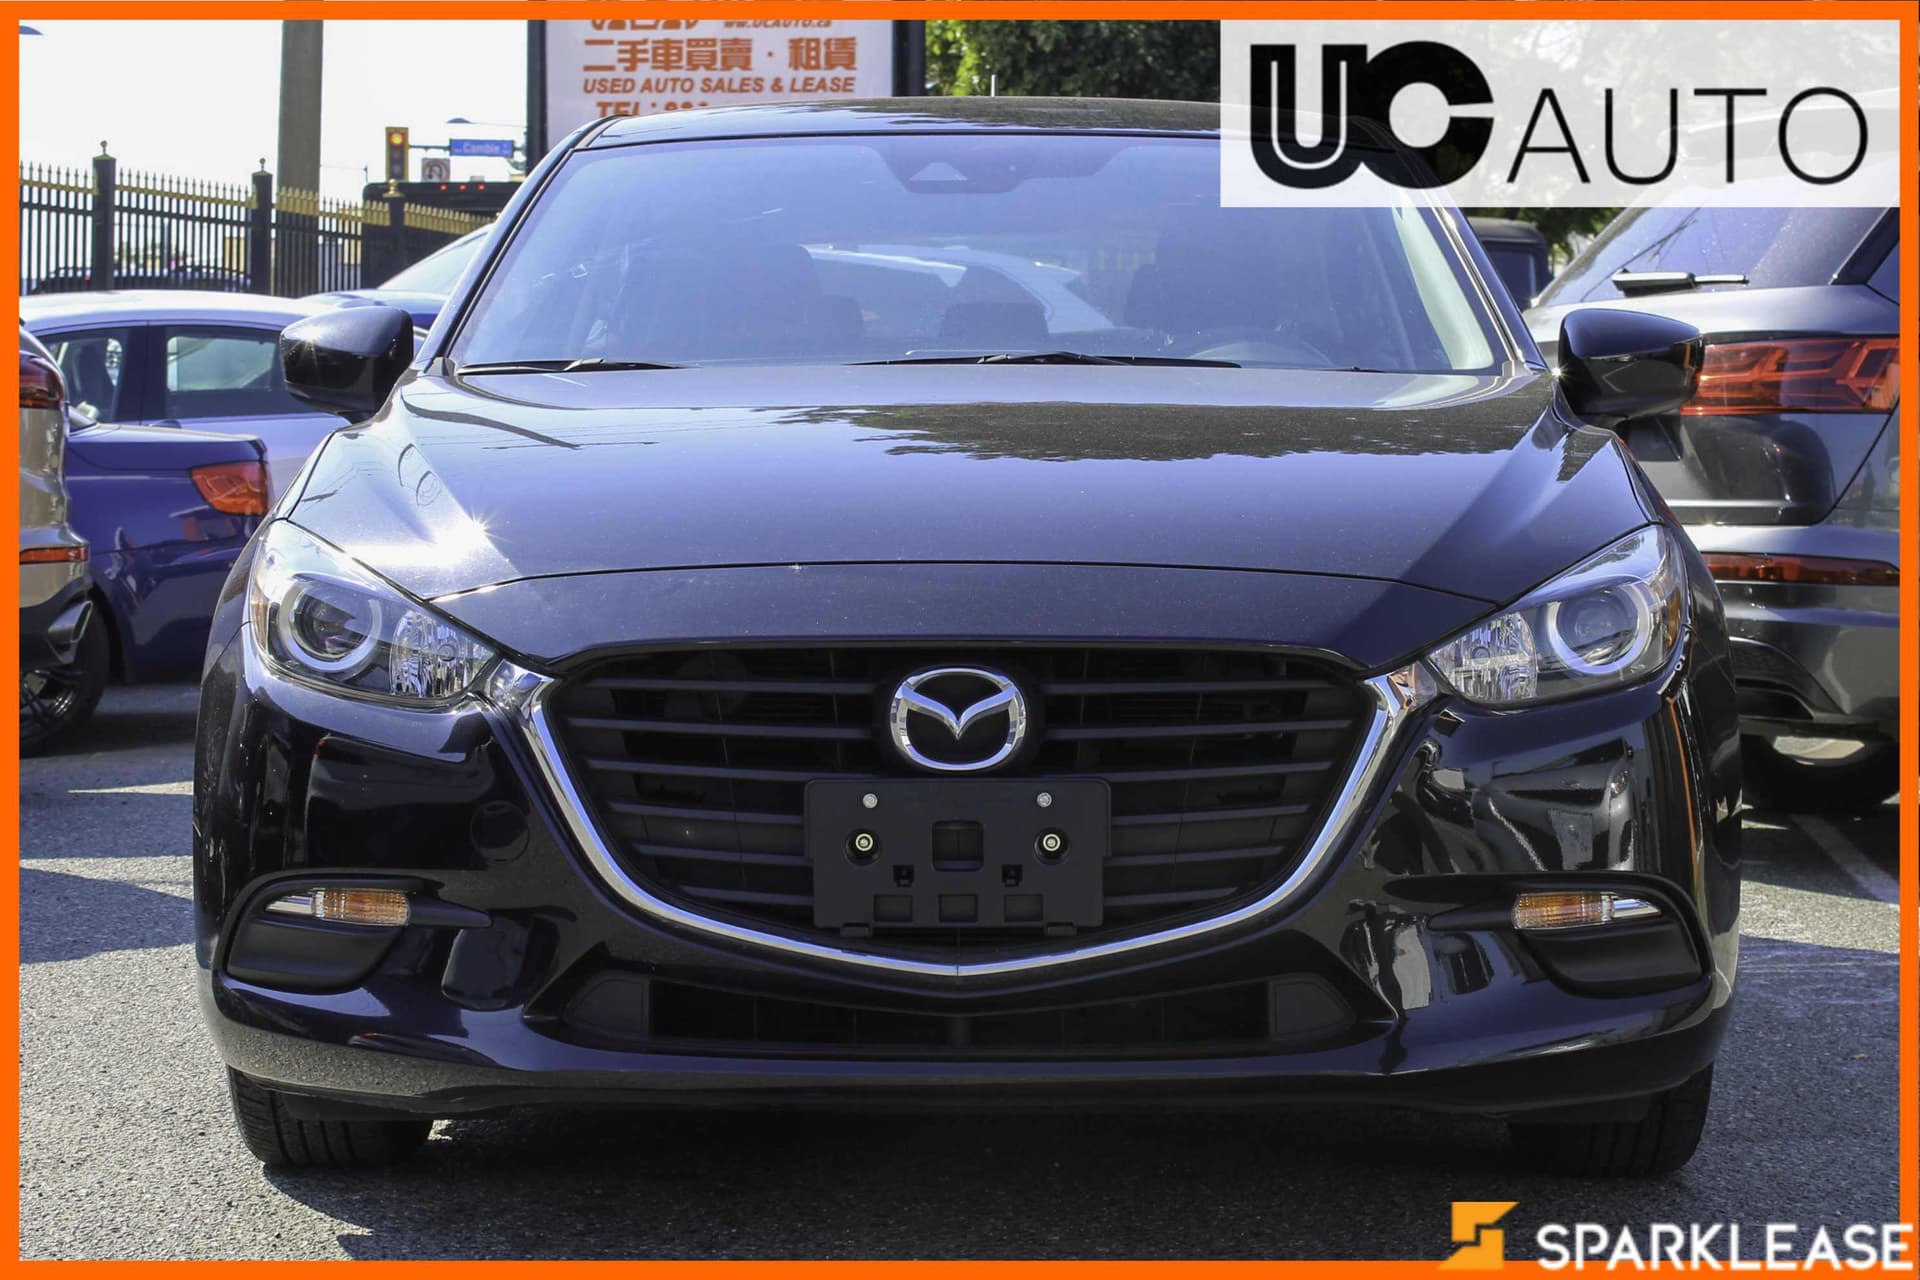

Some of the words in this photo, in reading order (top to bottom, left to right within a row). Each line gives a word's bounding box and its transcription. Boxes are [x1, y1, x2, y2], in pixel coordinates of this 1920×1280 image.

[583, 38, 752, 71] 二手車買賣
[788, 37, 857, 70] 租賃
[583, 78, 636, 94] USED
[640, 78, 694, 94] AUTO
[701, 77, 764, 93] SALES
[770, 77, 783, 92] &
[790, 76, 856, 93] LEASE
